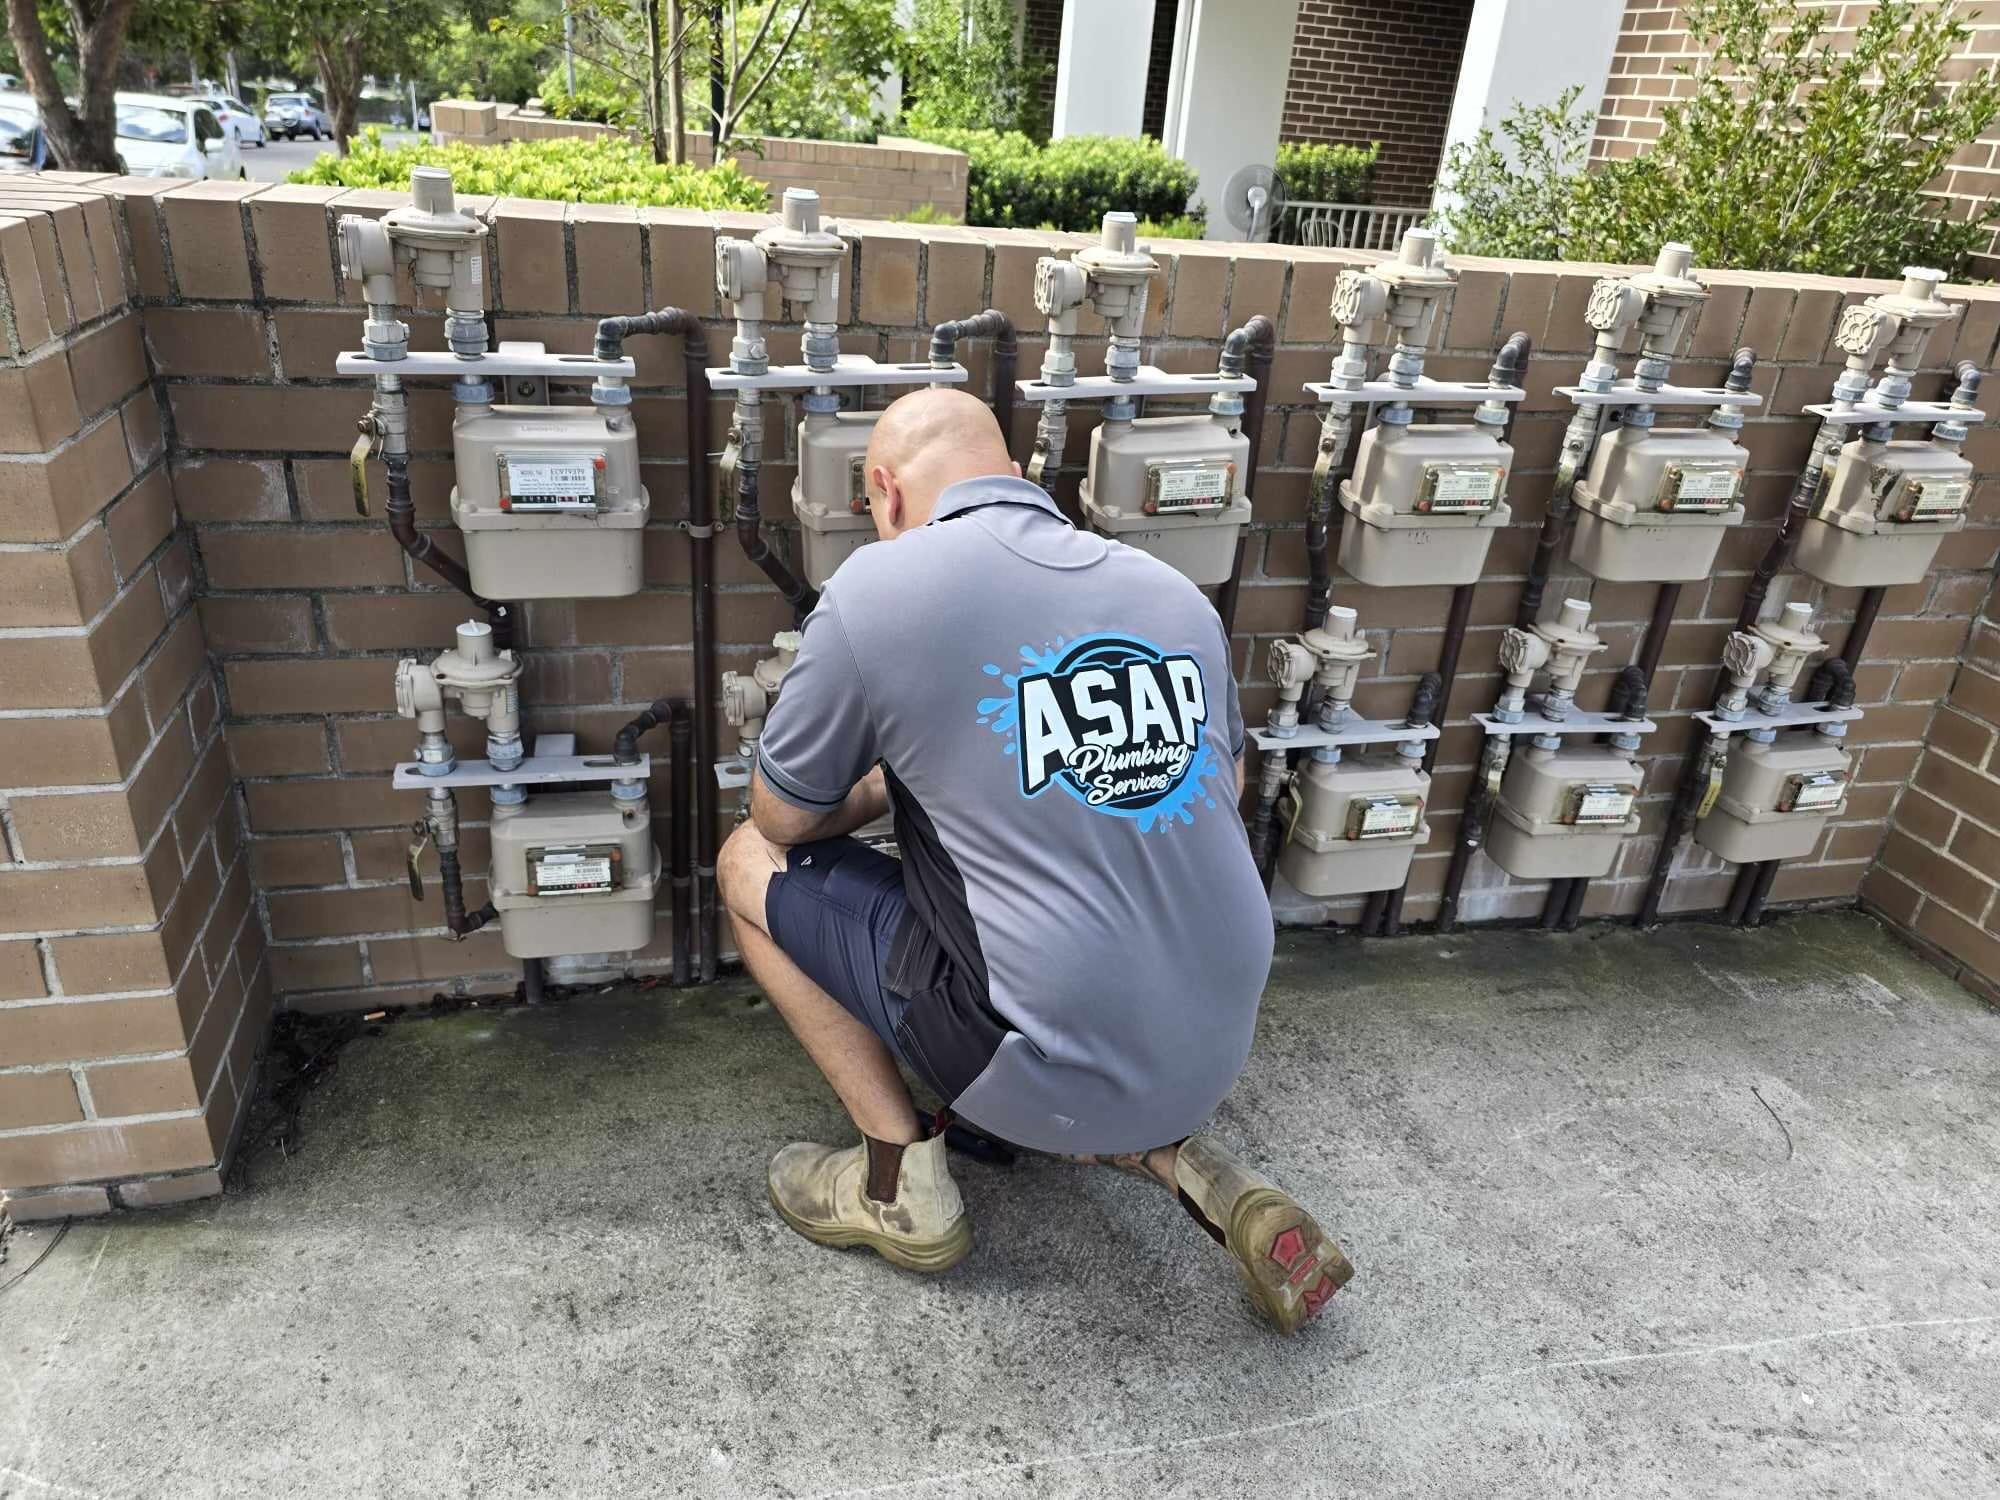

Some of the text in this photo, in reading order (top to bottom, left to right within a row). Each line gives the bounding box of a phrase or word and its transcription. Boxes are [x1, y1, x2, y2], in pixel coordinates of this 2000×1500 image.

[1023, 659, 1206, 789] ASAP
[1070, 741, 1190, 783] Plumbing
[1088, 773, 1169, 804] Services
